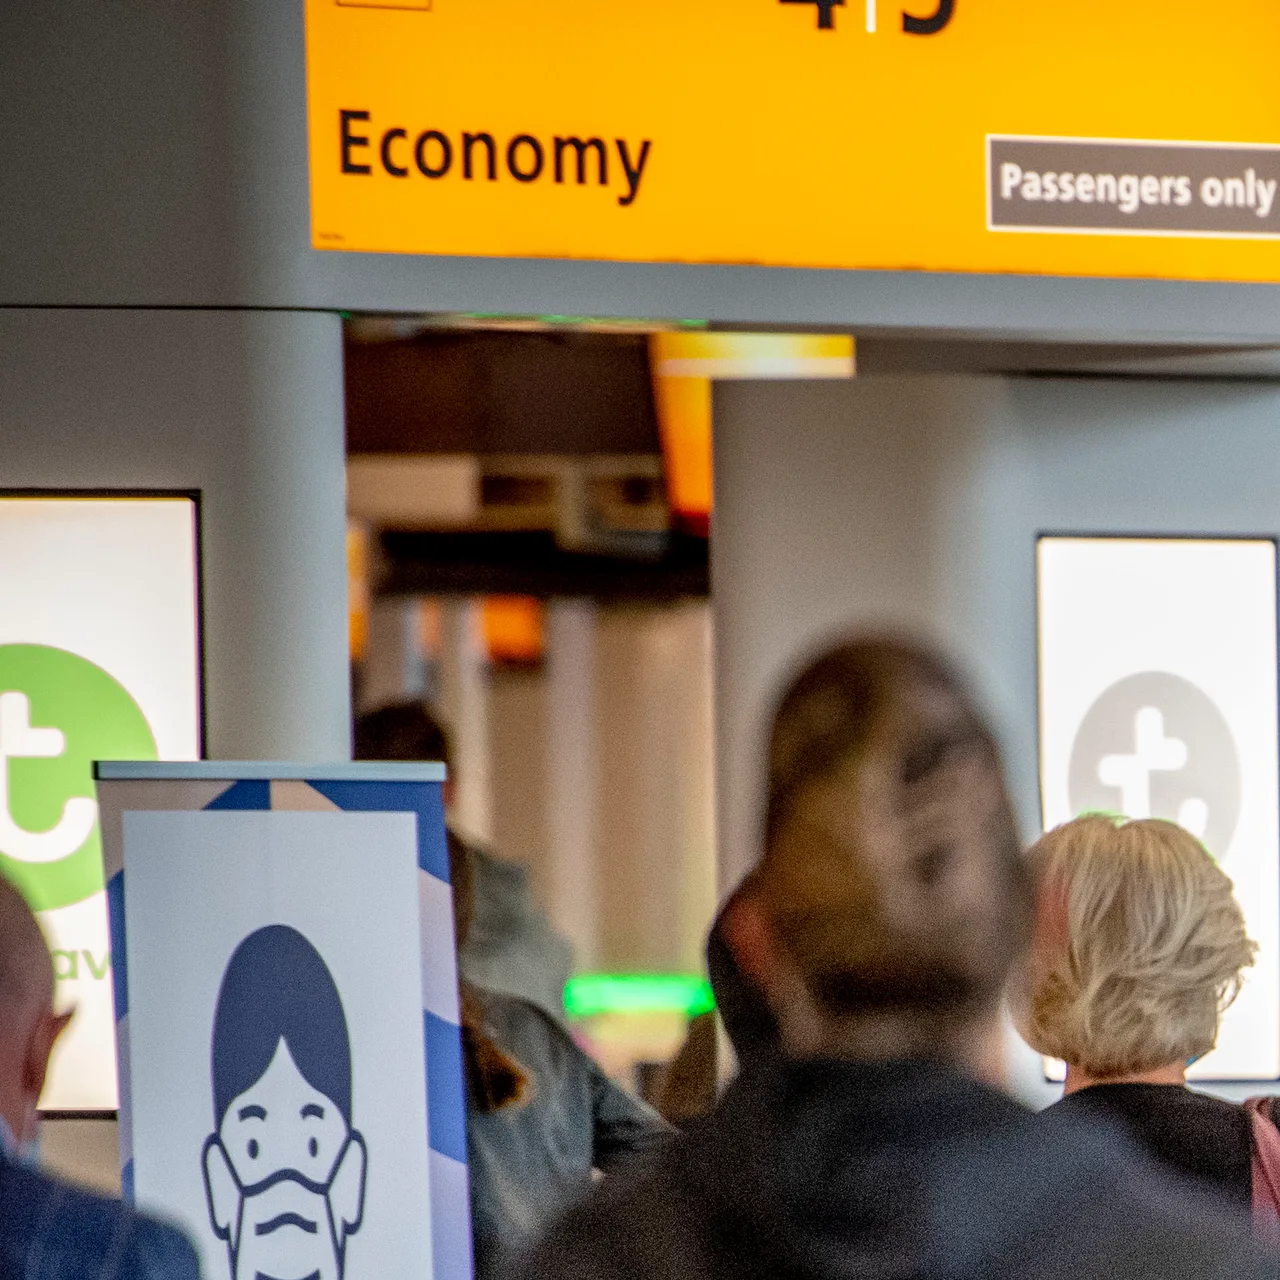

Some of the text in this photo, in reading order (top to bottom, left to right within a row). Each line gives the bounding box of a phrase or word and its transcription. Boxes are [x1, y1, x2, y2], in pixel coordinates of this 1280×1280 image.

[338, 109, 653, 207] Economy
[1000, 162, 1277, 218] Passengers only
